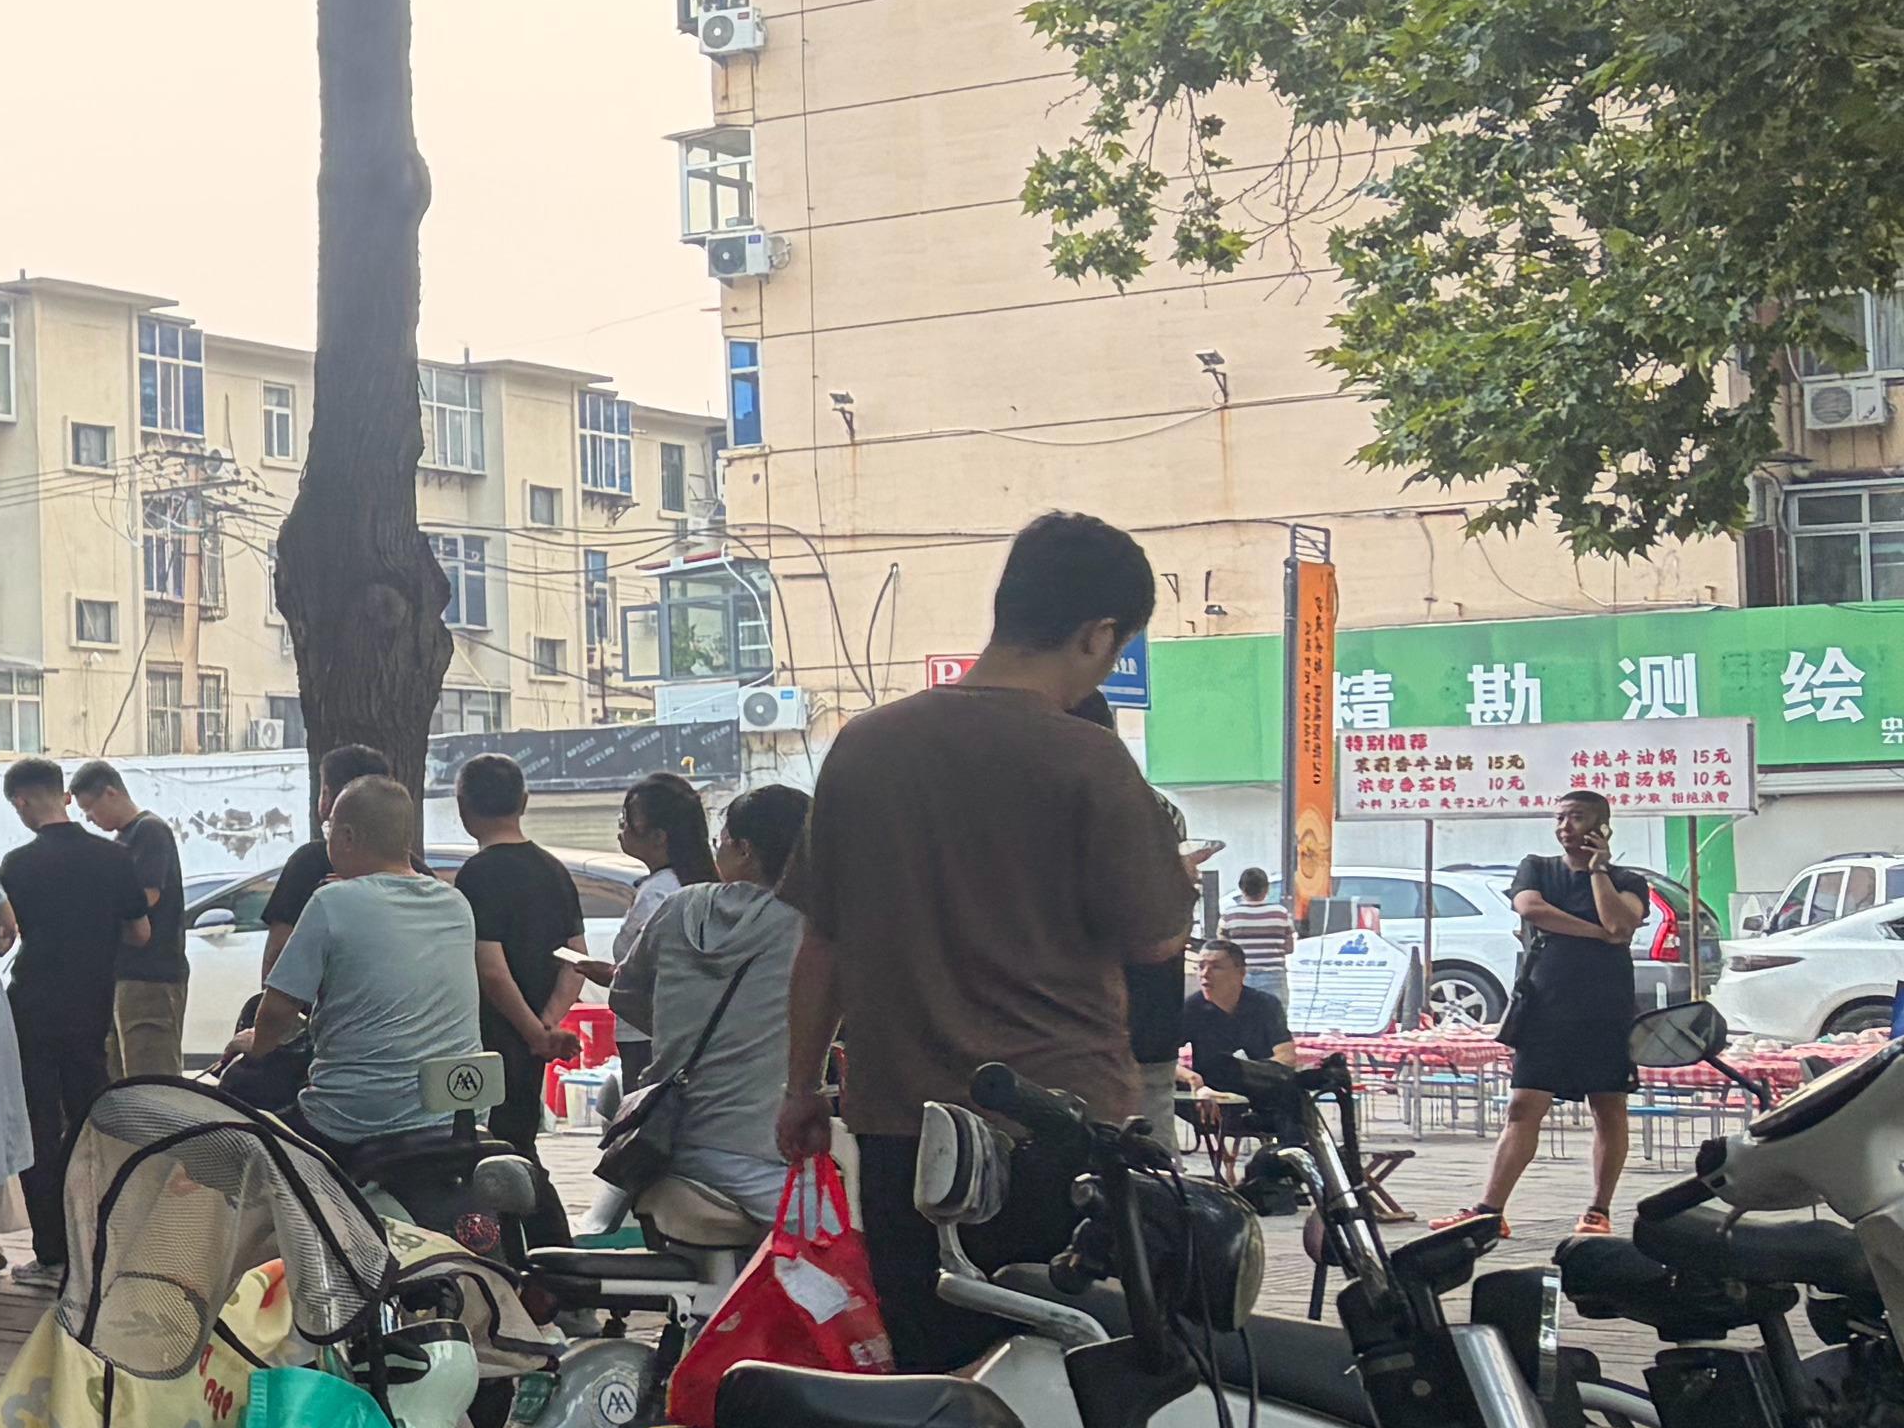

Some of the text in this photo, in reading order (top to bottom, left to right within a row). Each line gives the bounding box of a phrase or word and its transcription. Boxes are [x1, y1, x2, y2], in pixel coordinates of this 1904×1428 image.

[1345, 733, 1428, 752] 特别推荐
[1488, 754, 1526, 770] 15元
[1570, 748, 1732, 768] 传统牛油锅 15元
[1488, 775, 1526, 791] 10元
[1693, 771, 1732, 786] 10元
